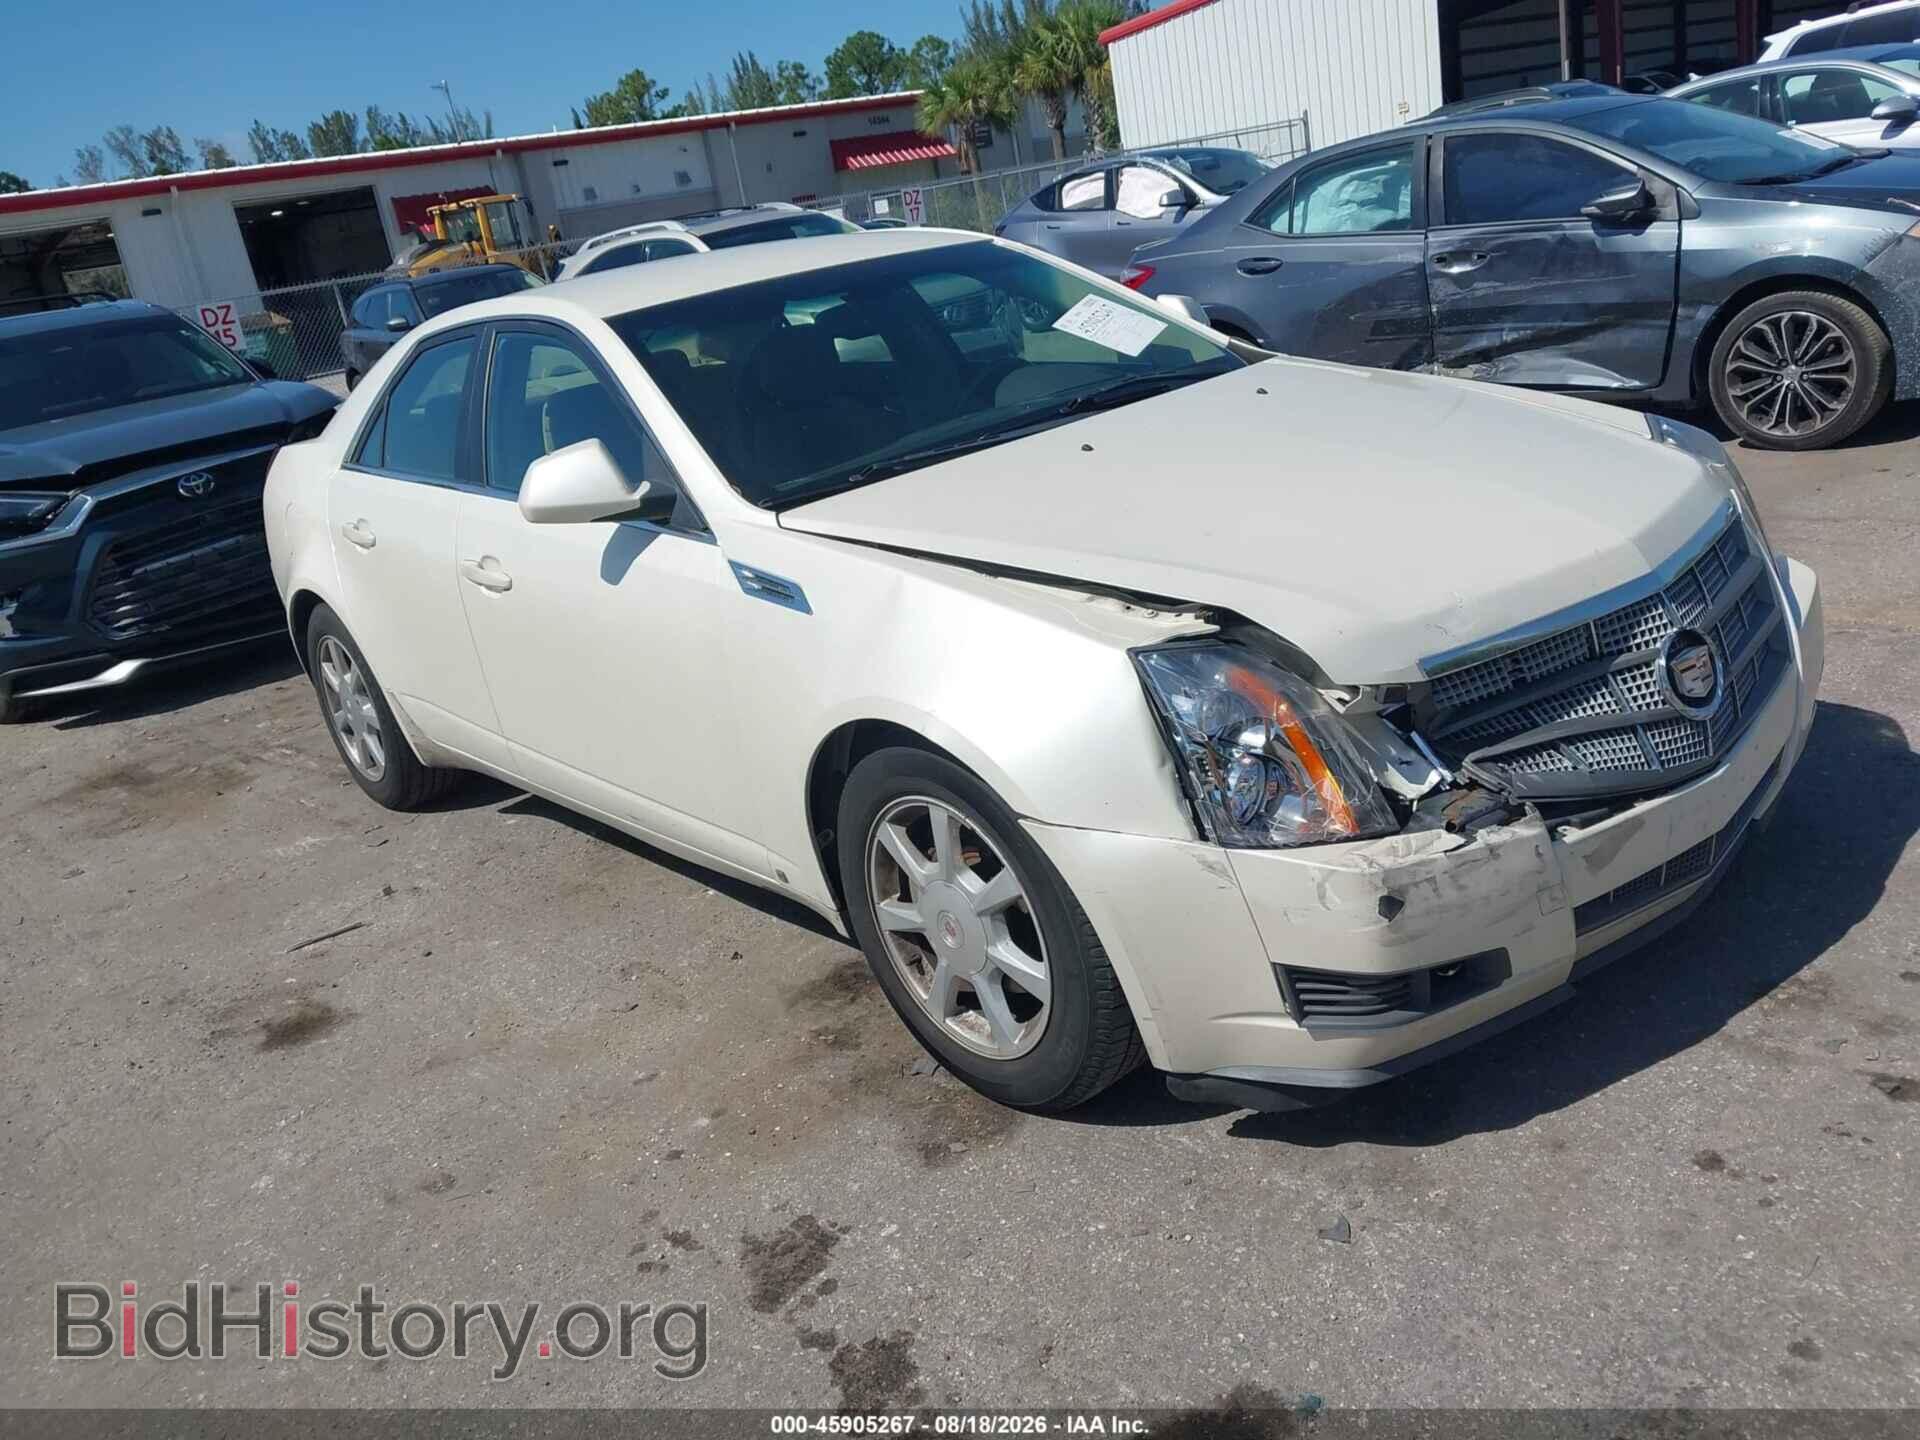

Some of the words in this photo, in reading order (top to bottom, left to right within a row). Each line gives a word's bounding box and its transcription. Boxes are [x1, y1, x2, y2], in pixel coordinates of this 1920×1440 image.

[903, 190, 922, 206] DZ
[909, 207, 920, 222] 17
[200, 304, 236, 328] DZ
